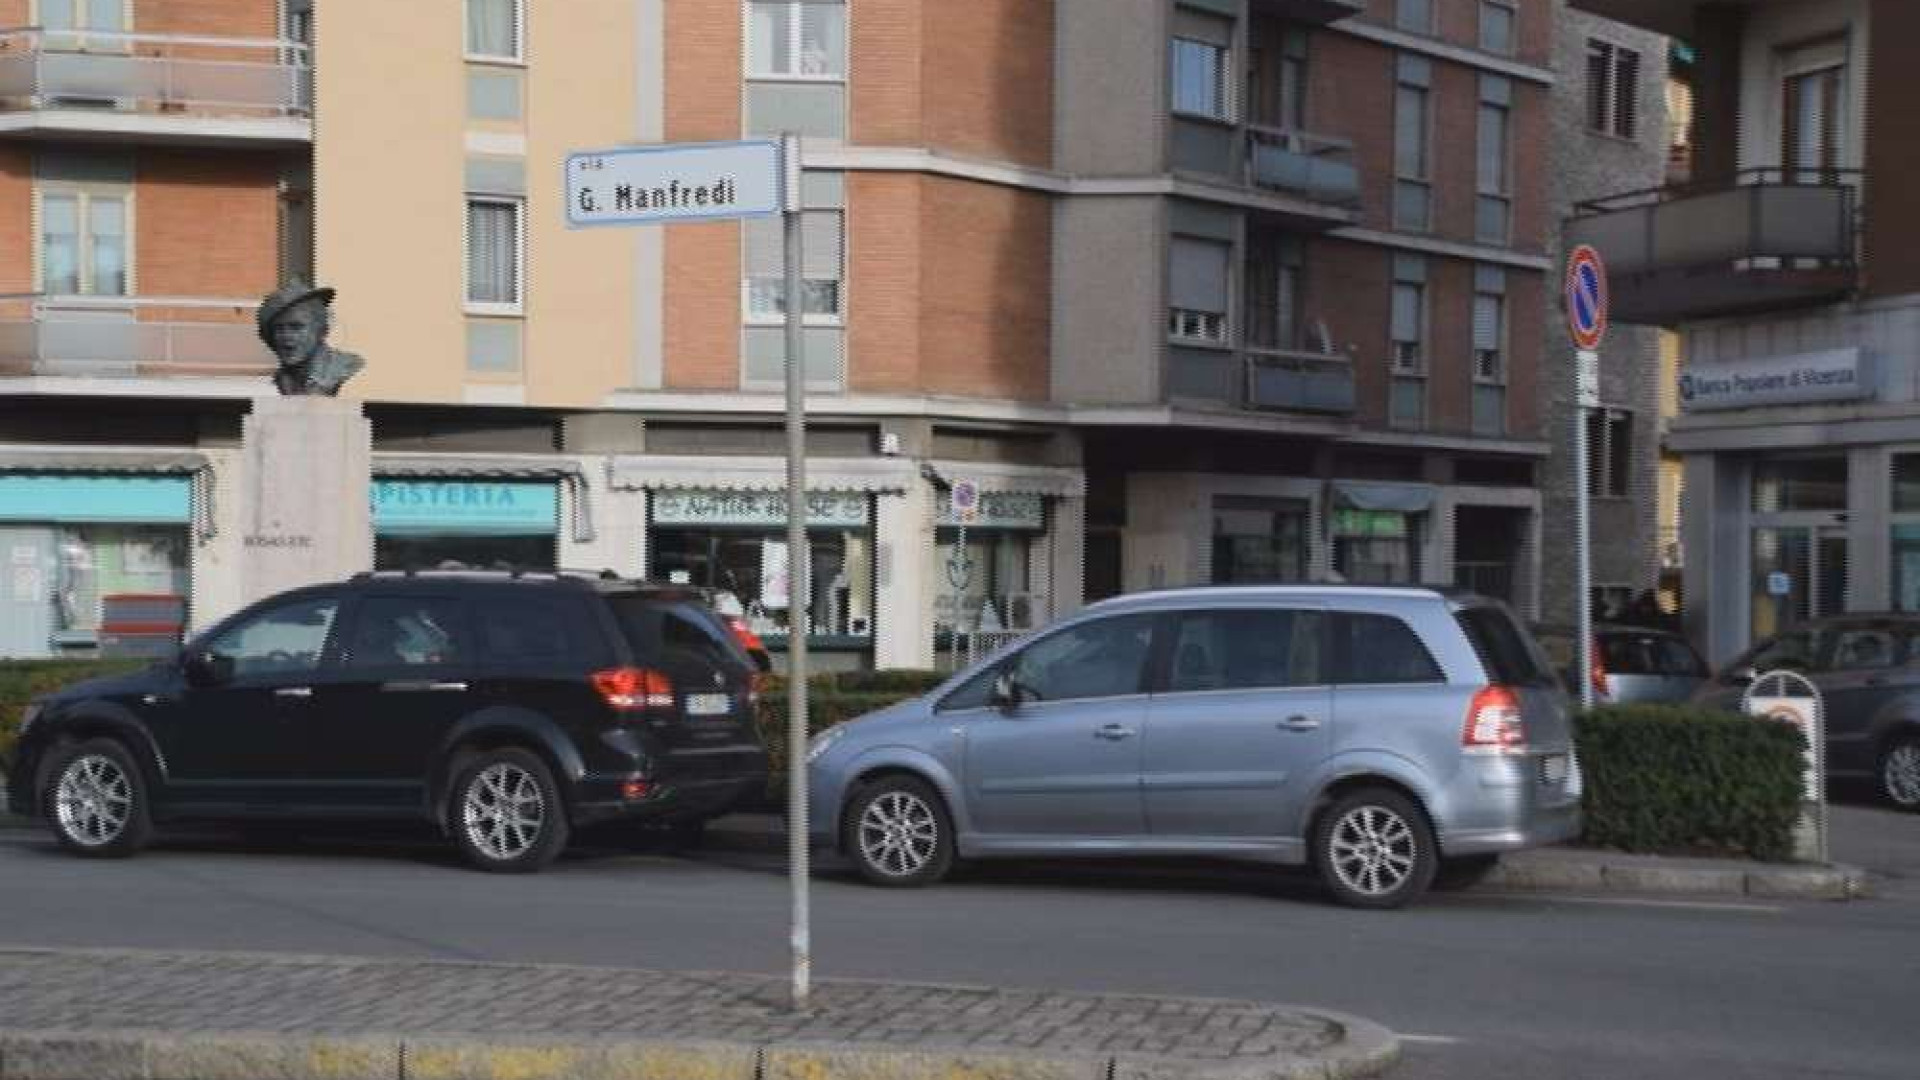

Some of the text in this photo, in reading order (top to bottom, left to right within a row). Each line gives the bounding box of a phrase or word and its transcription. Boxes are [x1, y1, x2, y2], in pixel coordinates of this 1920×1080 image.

[577, 177, 737, 212] G. Manfredi
[370, 481, 516, 506] PISTERIA
